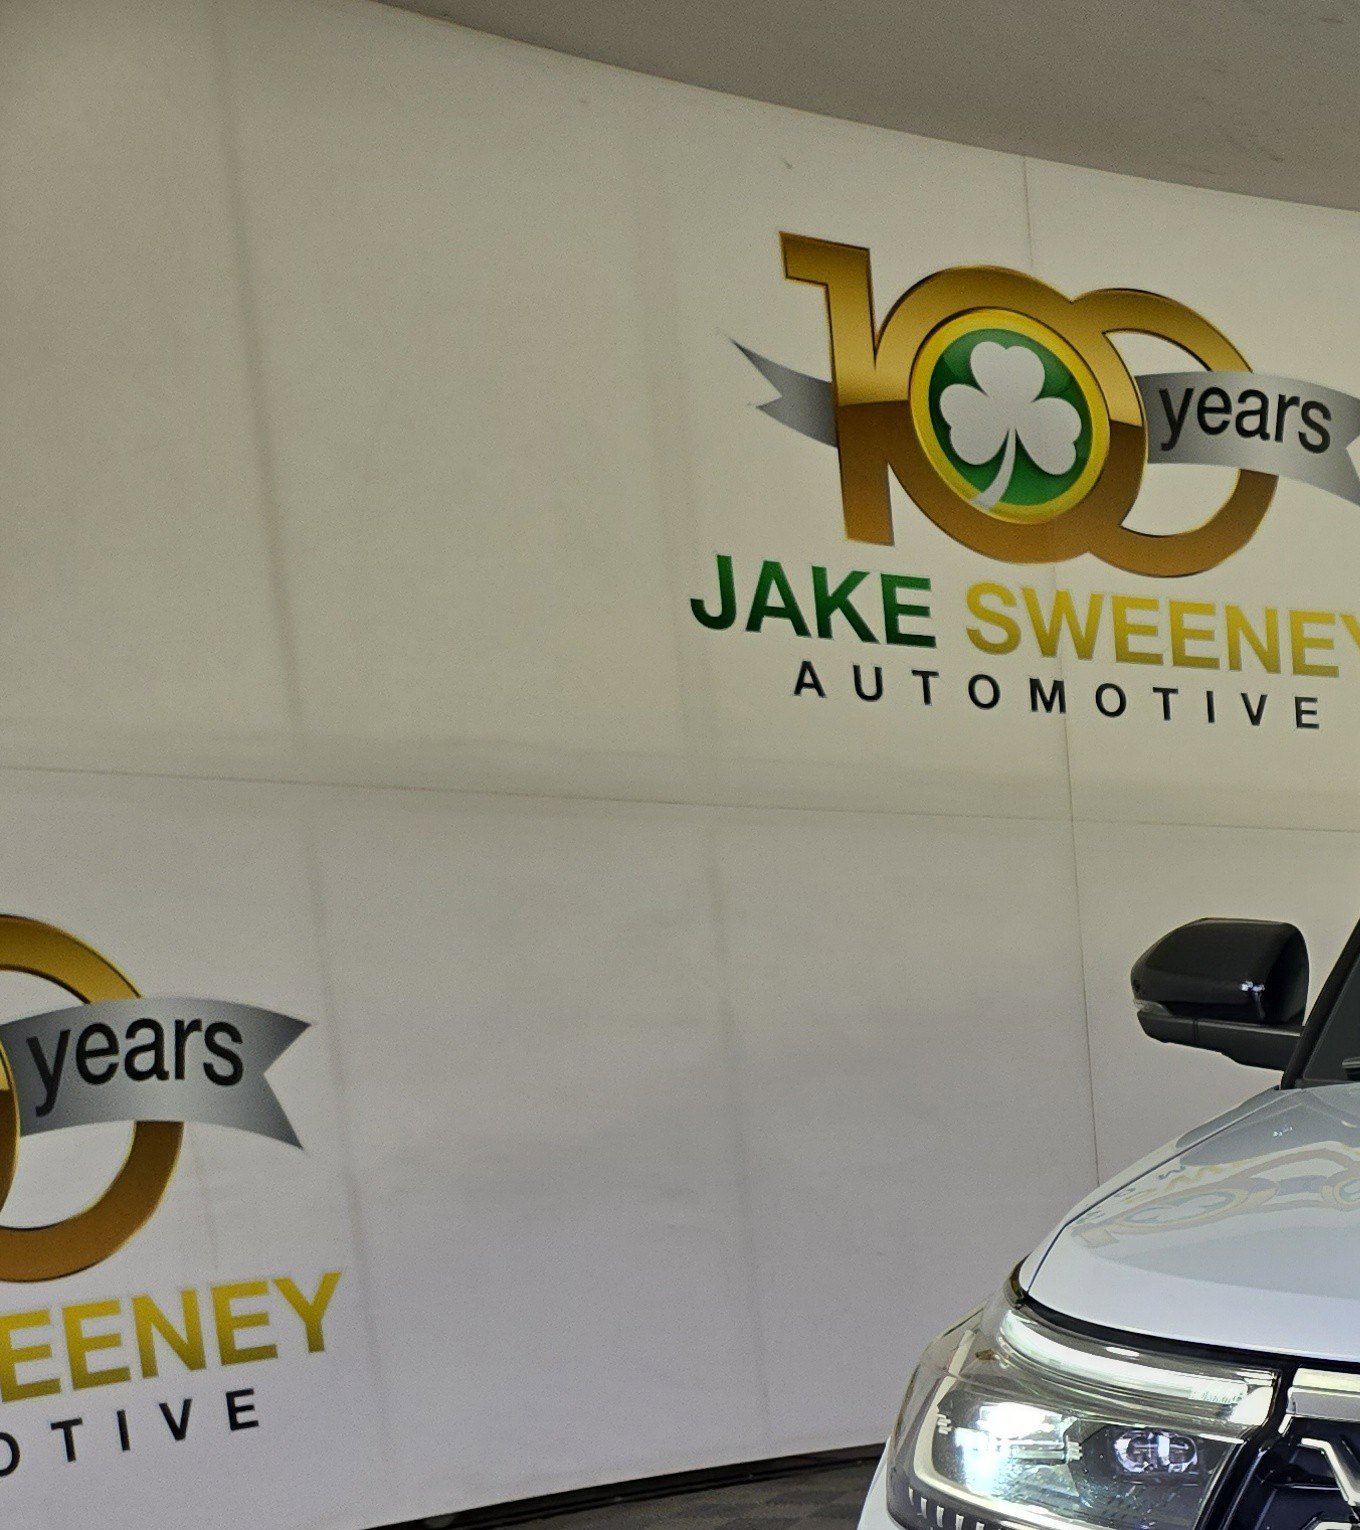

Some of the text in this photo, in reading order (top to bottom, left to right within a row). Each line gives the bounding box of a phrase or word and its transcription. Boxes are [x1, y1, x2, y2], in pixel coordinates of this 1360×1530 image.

[1157, 385, 1335, 454] years
[689, 554, 936, 650] JAKE
[792, 661, 1321, 730] AUTOMOTIVE
[26, 1017, 244, 1117] years
